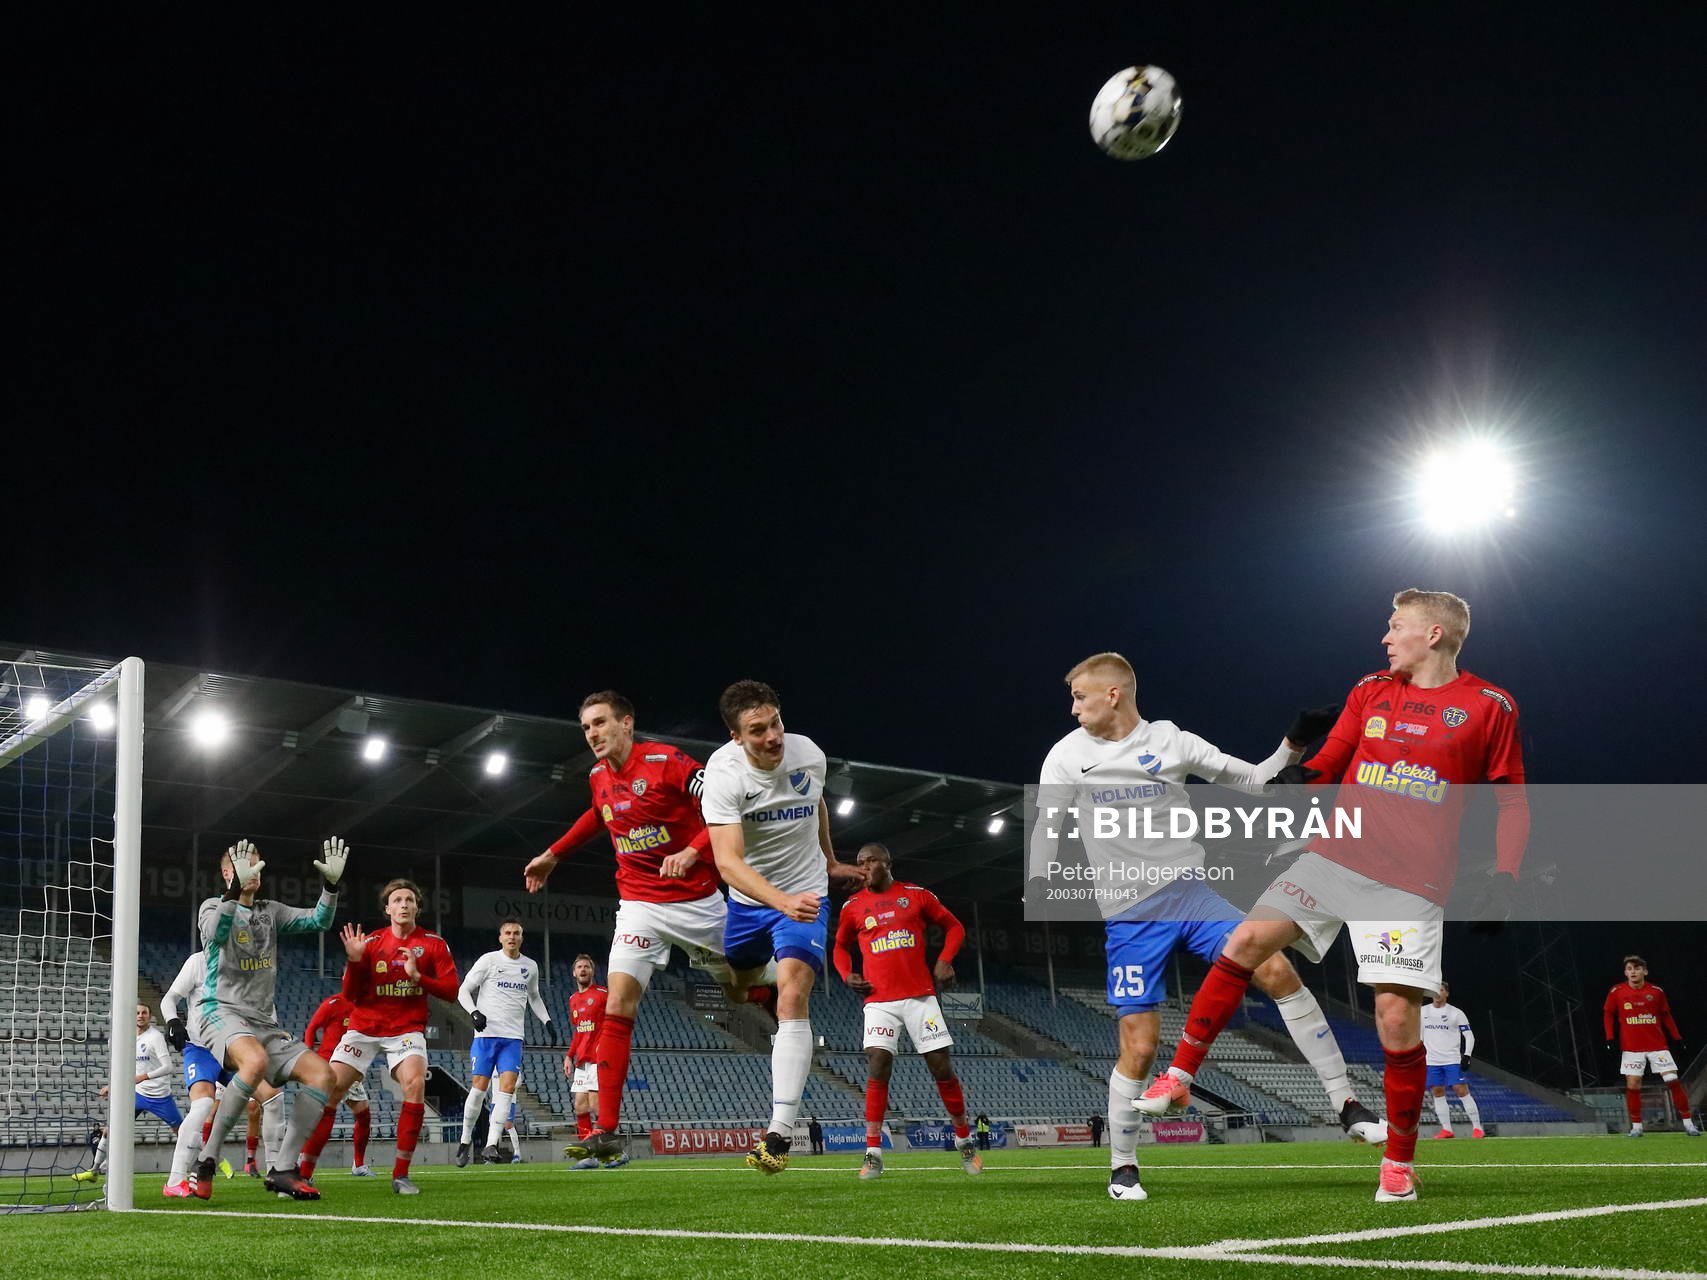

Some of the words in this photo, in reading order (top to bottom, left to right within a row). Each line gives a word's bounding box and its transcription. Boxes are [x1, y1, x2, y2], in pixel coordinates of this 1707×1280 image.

[1402, 701, 1437, 716] FBG
[1392, 760, 1437, 782] Gekås
[1356, 761, 1449, 804] Ullared
[1091, 783, 1167, 804] HOLMEN
[744, 804, 814, 823] HOLMEN
[615, 825, 672, 854] Ullared
[628, 824, 658, 840] Gekås
[870, 934, 916, 955] Ullared
[1360, 953, 1384, 965] SPECIAL
[1391, 956, 1424, 970] KAROSSER
[497, 980, 529, 991] HOLMEN
[1112, 965, 1145, 998] 25
[1626, 1016, 1657, 1025] Ullared
[187, 1063, 196, 1080] 5
[663, 1131, 762, 1150] BAUHAUS
[828, 1133, 845, 1145] Heja
